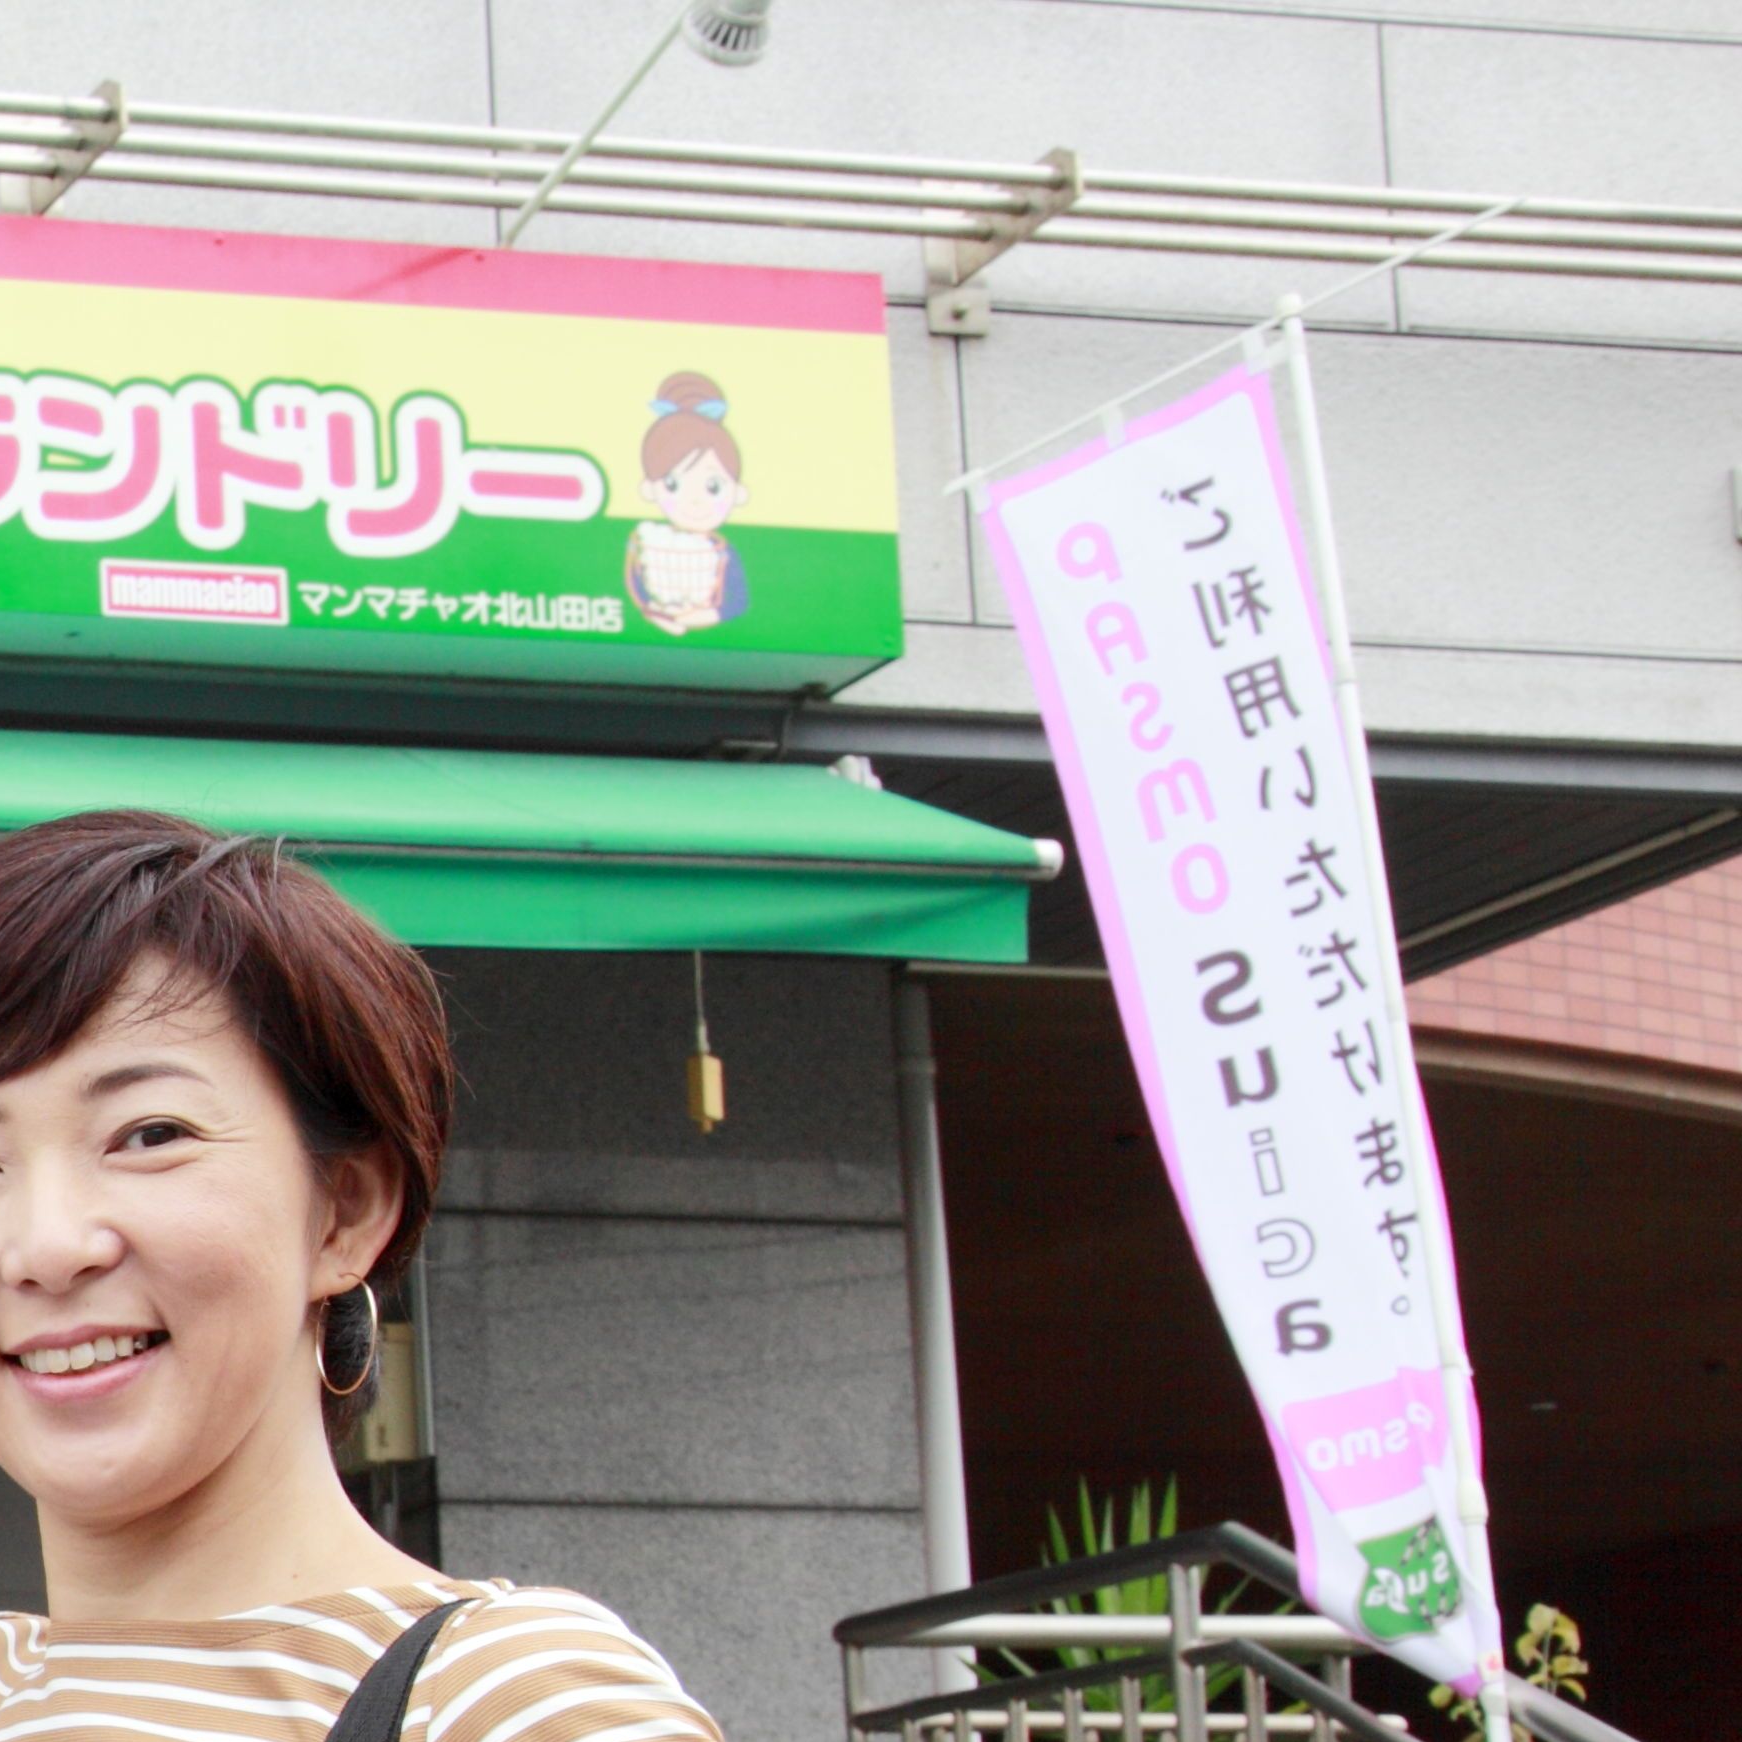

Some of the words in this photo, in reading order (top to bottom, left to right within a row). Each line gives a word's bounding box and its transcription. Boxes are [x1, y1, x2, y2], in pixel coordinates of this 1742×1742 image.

[110, 573, 278, 616] mammaciao
[297, 581, 624, 634] マンマチャオ北山田店
